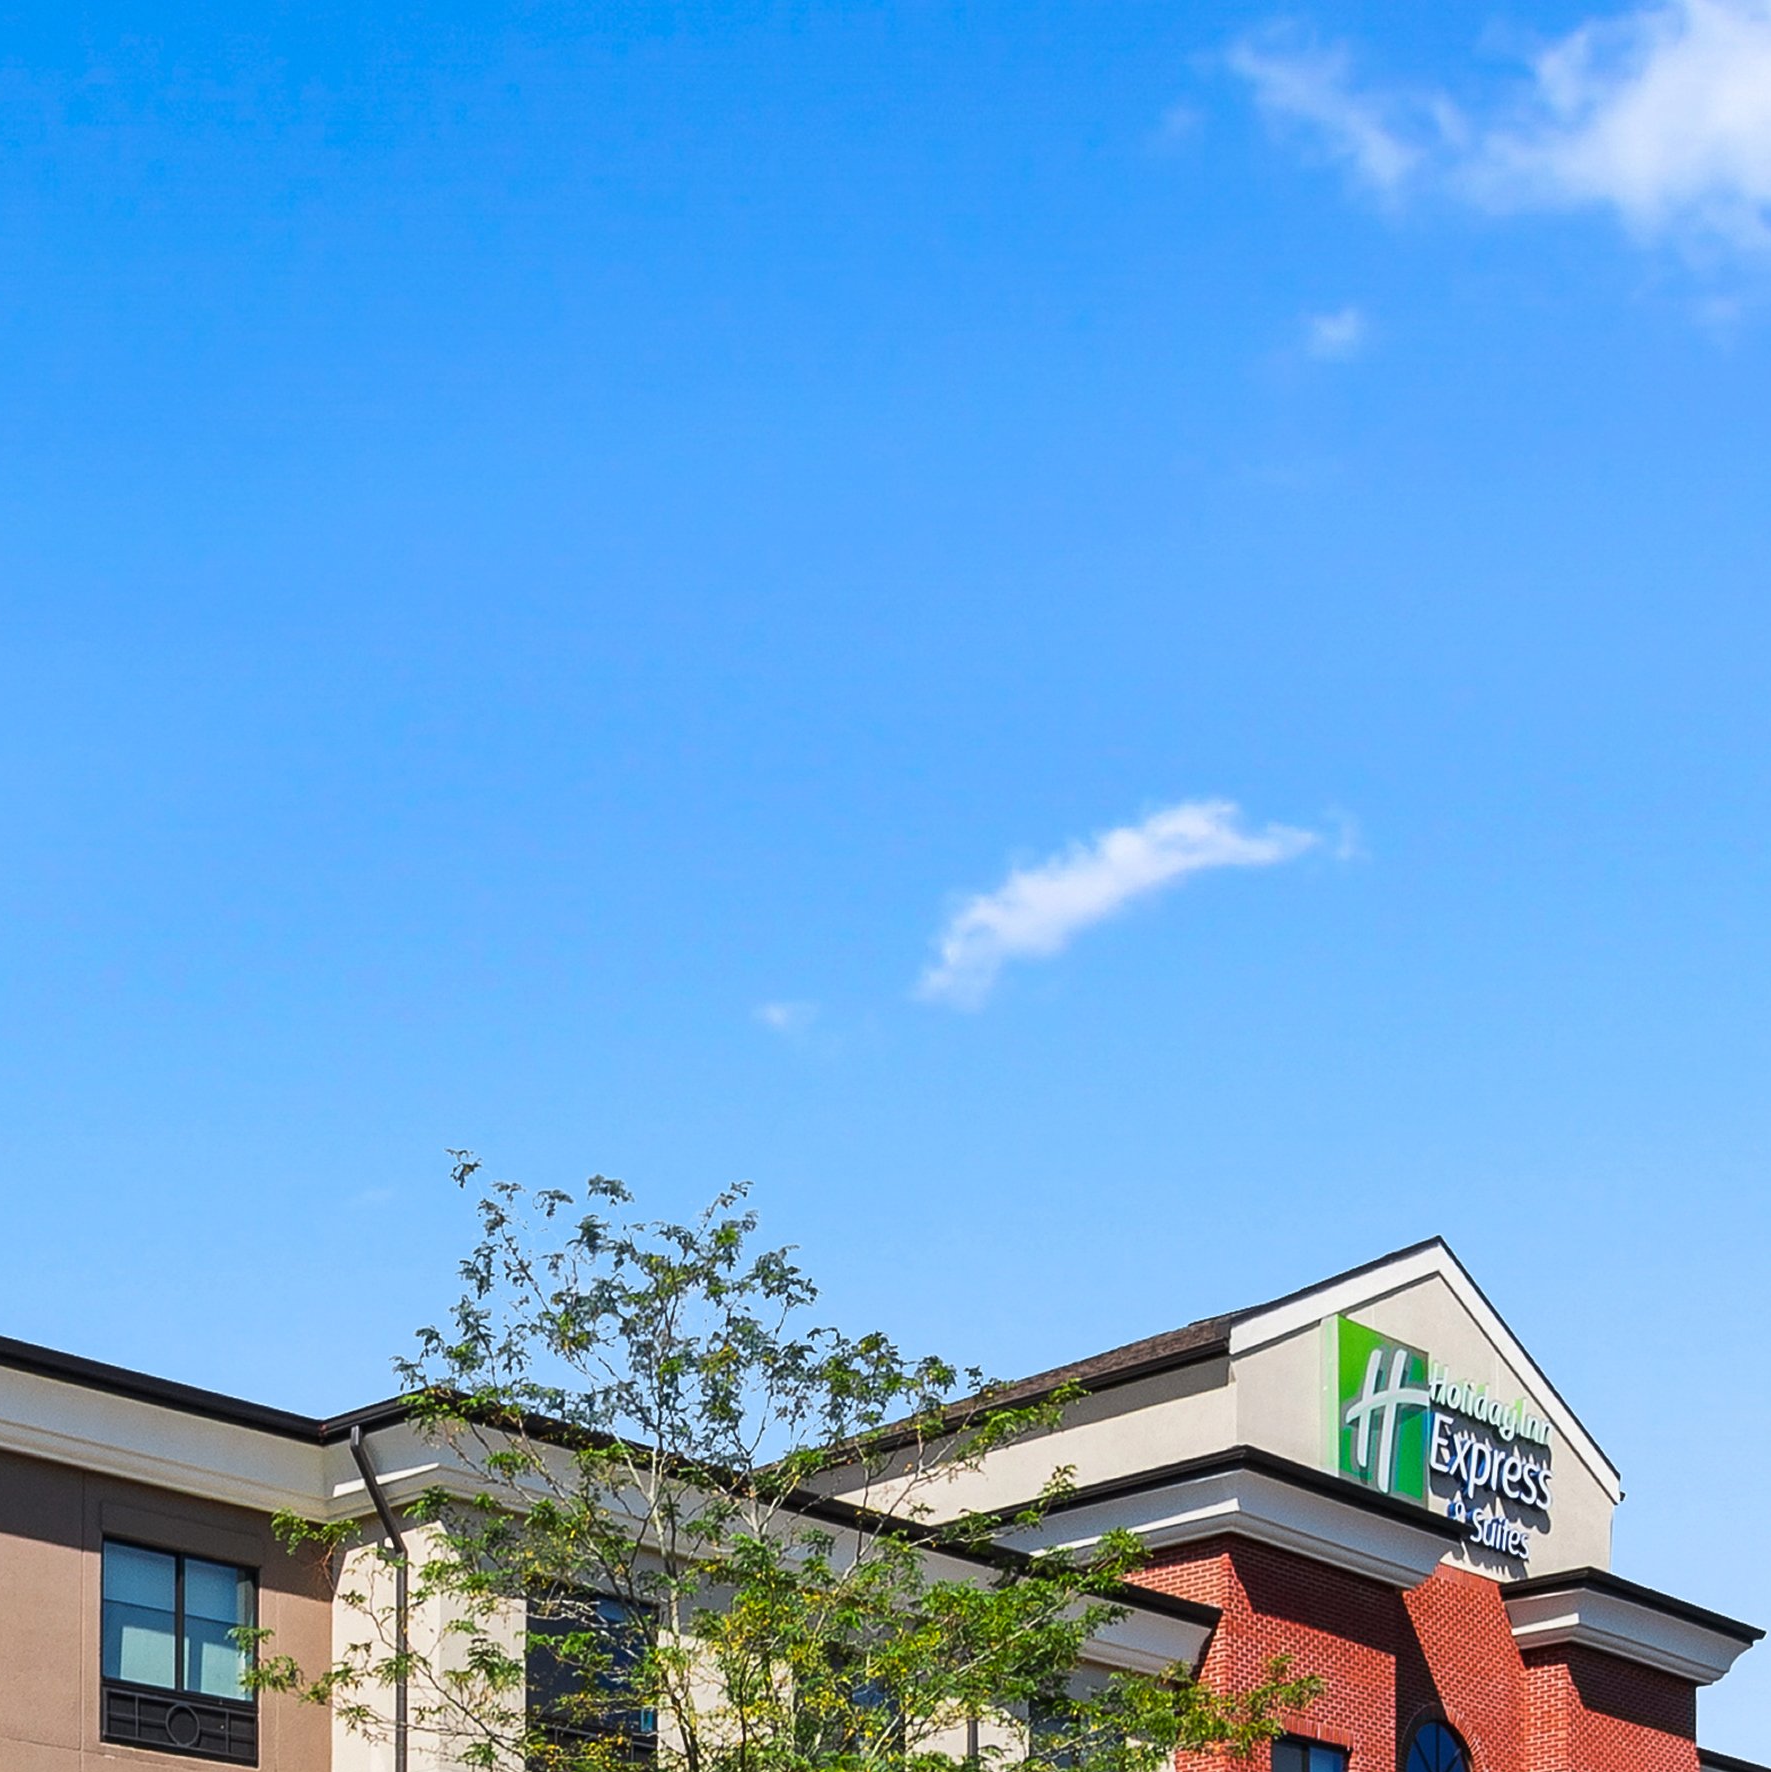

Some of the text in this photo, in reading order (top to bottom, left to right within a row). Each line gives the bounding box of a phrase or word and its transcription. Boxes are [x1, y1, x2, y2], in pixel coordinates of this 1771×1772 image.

[1429, 1362, 1552, 1444] Holiday Inn
[1430, 1412, 1553, 1510] Express
[1470, 1507, 1529, 1559] Suites
